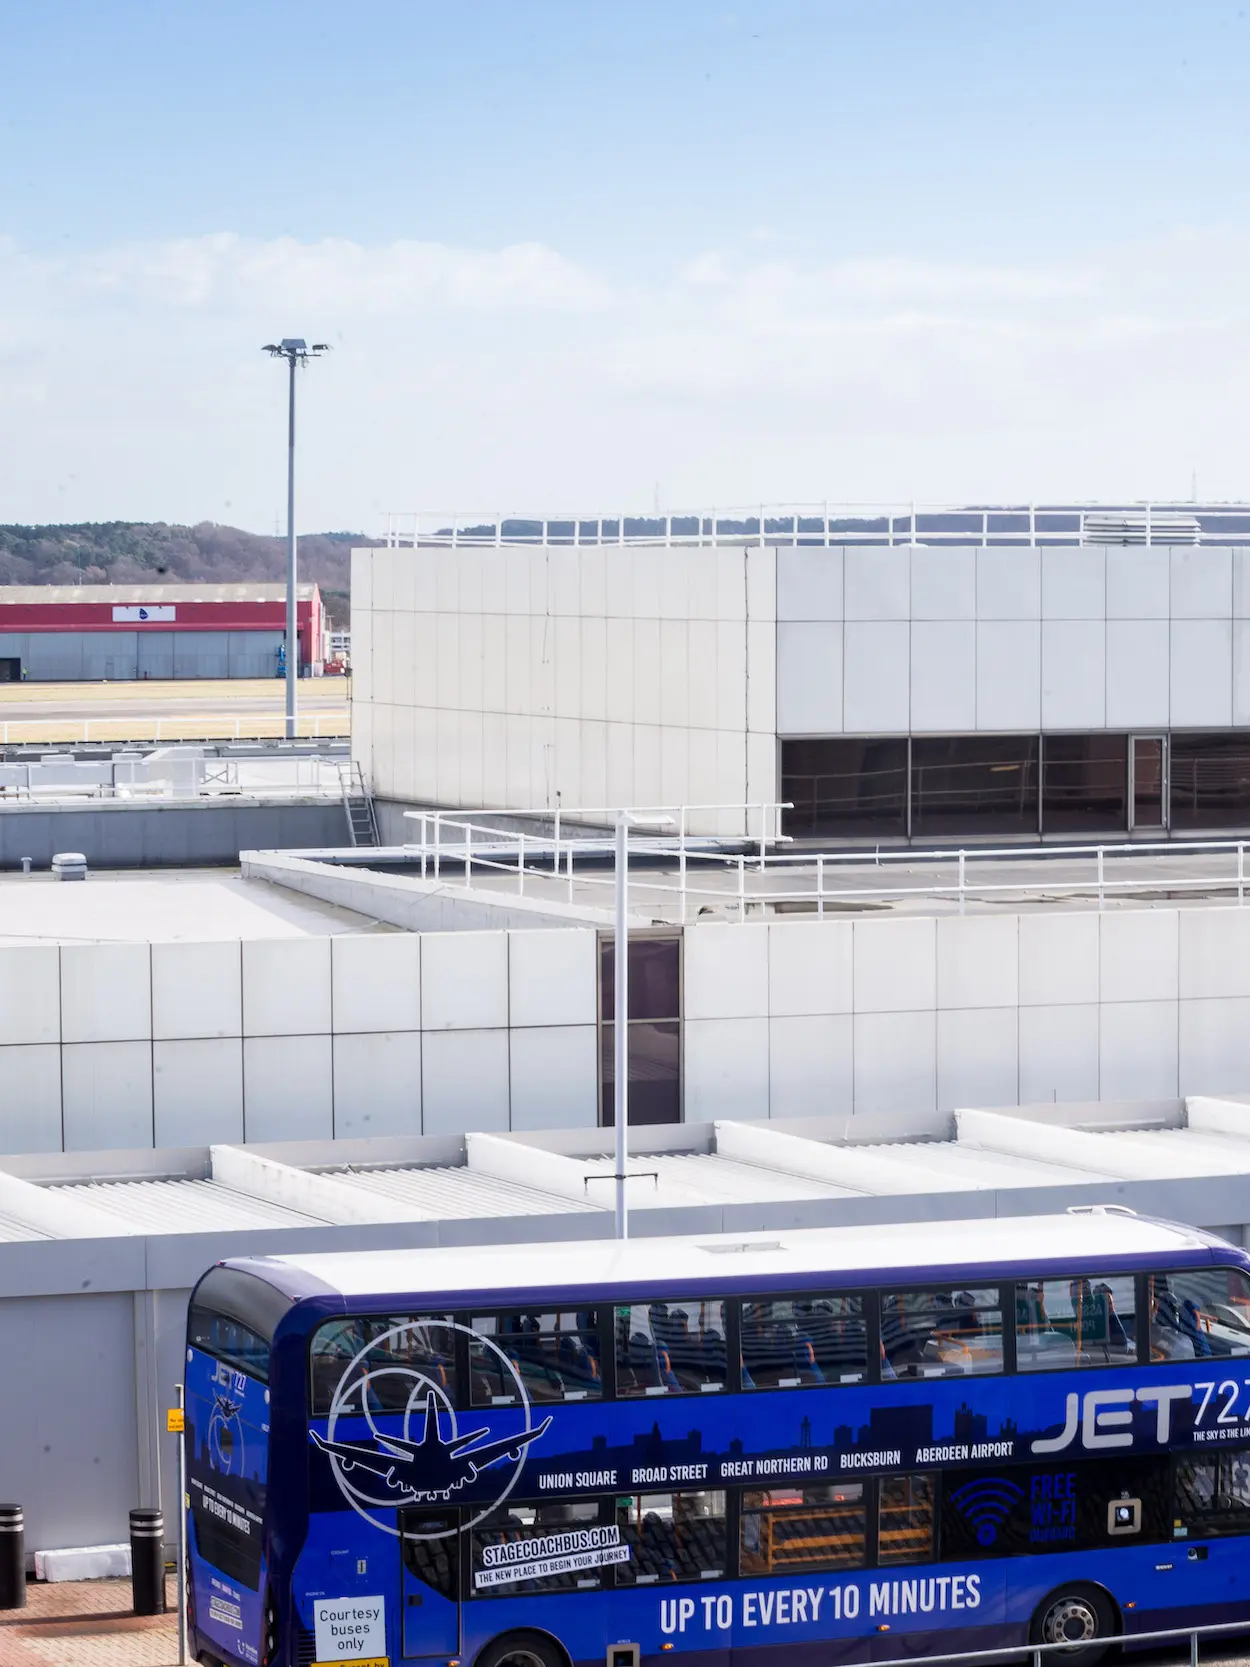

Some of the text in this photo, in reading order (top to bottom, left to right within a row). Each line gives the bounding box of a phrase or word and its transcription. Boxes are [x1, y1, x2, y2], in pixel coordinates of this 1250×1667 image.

[1030, 1384, 1193, 1454] JET
[1193, 1431, 1205, 1442] THE
[1206, 1430, 1218, 1441] SKY
[1219, 1429, 1226, 1440] IS
[1226, 1428, 1238, 1439] THE
[840, 1450, 901, 1469] BUCKSBURN
[915, 1440, 1014, 1464] ABERDEEN AIRPORT
[632, 1464, 708, 1484] BROAD STREET
[720, 1455, 828, 1478] GREAT NORTHERN RD
[539, 1470, 617, 1490] UNION SQUARE
[1031, 1473, 1076, 1500] FREE
[1031, 1501, 1076, 1525] WI-FI
[484, 1526, 619, 1565] STAGECOACHBUS.COM
[479, 1550, 628, 1584] THE NEW PLACE TO BEGIN YOUR JOURNEY
[319, 1608, 380, 1622] Courtesy
[661, 1574, 981, 1634] UP TO EVERY 10 MINUTES
[331, 1624, 370, 1636] buses
[337, 1637, 364, 1651] only
